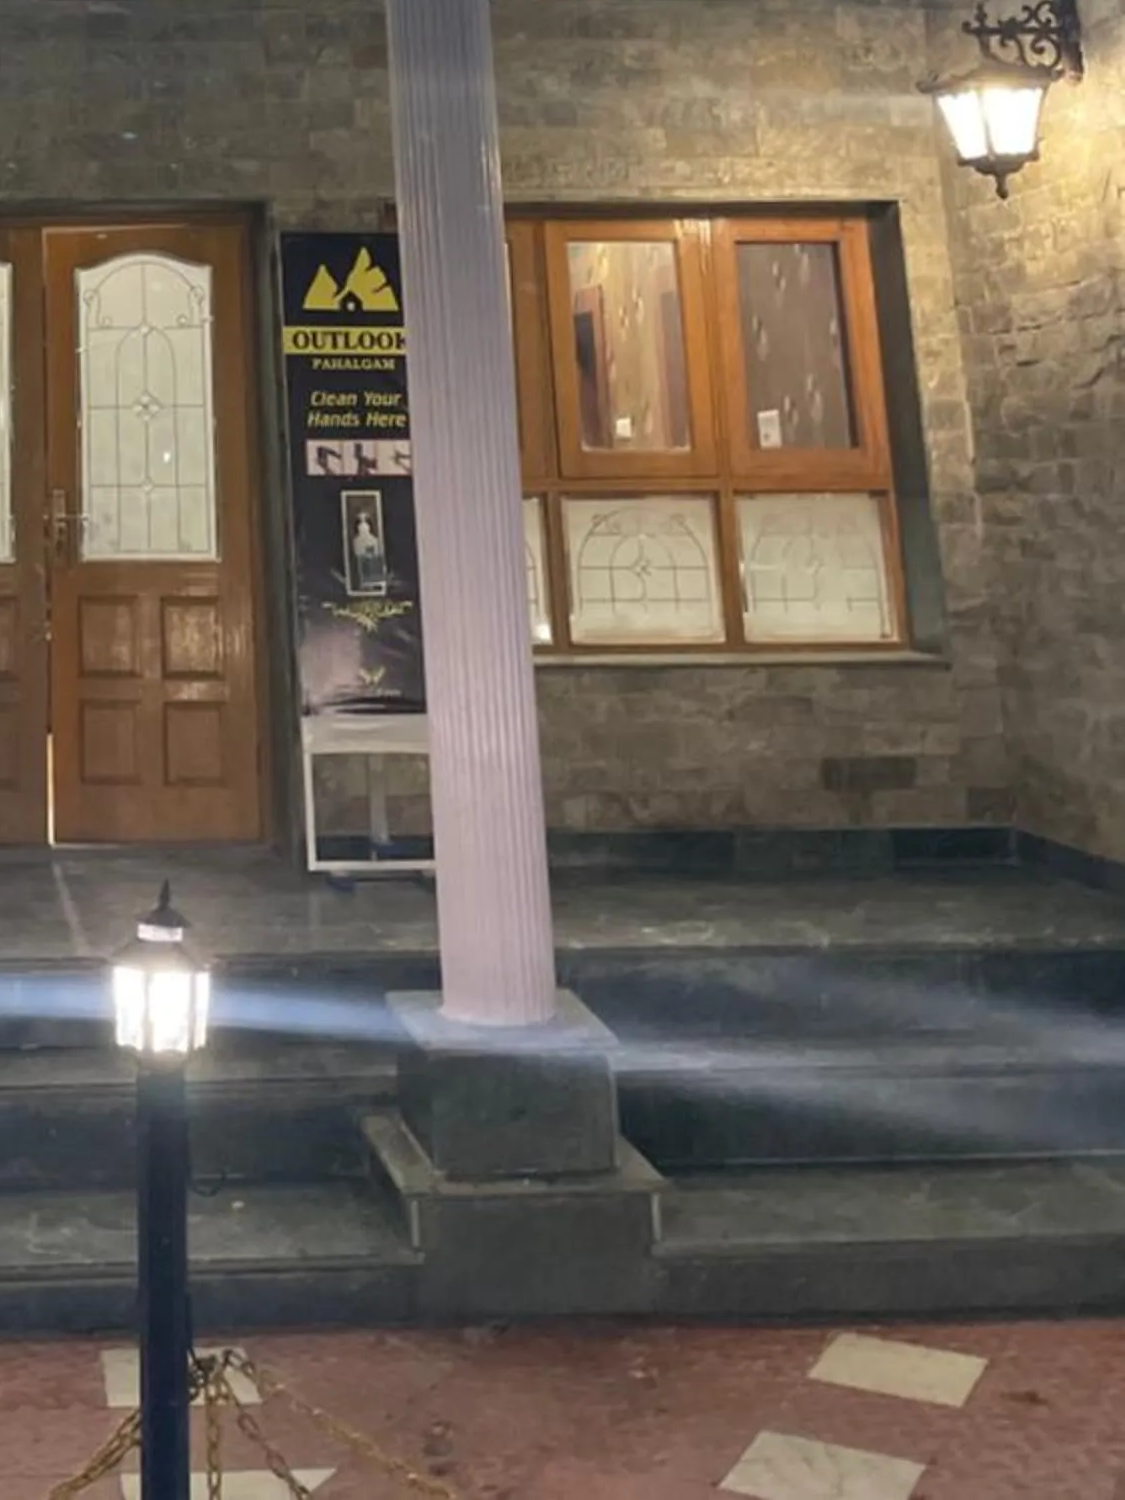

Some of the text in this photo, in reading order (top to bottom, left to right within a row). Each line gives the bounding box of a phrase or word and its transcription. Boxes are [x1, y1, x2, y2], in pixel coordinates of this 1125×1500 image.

[312, 358, 396, 370] PAHALGAM
[310, 391, 402, 406] Clean Your
[307, 411, 407, 428] Hands Here
